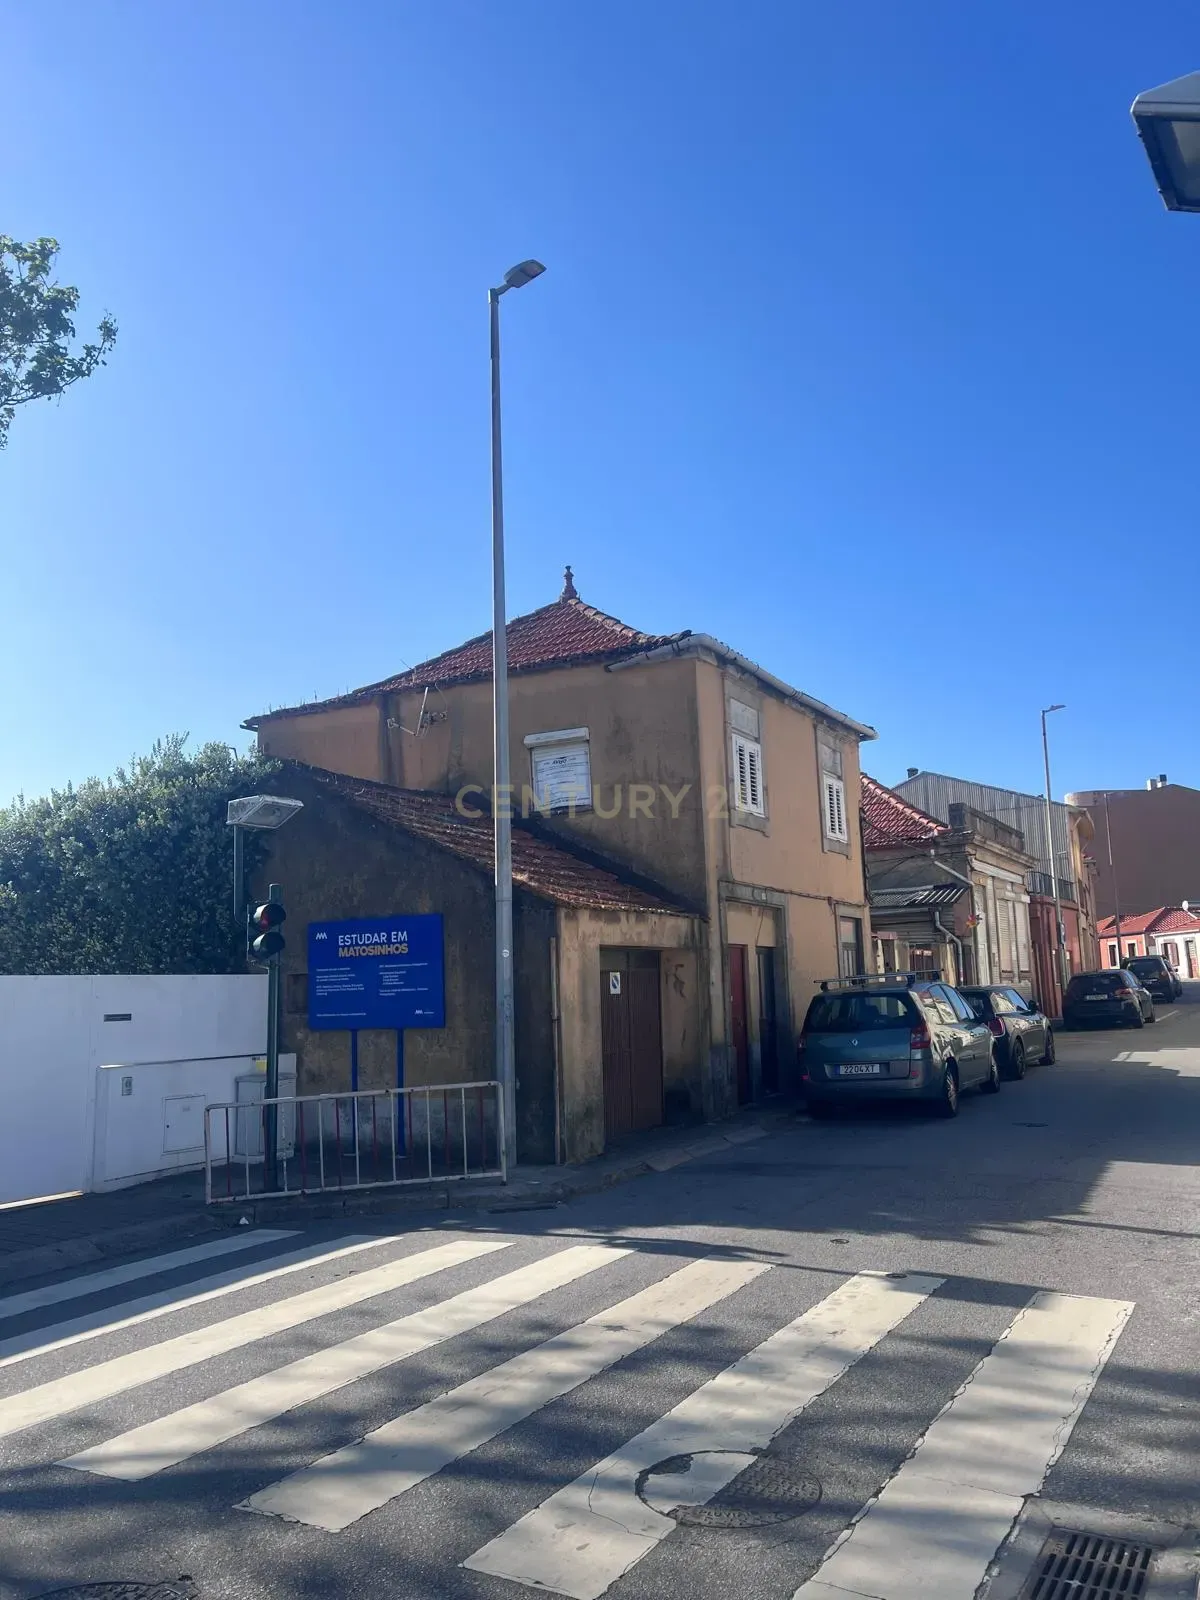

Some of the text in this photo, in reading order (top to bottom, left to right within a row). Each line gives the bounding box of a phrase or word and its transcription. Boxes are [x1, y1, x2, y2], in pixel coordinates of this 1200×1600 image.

[338, 931, 408, 945] ESTUDAR EM
[338, 943, 409, 957] MATOSINHOS
